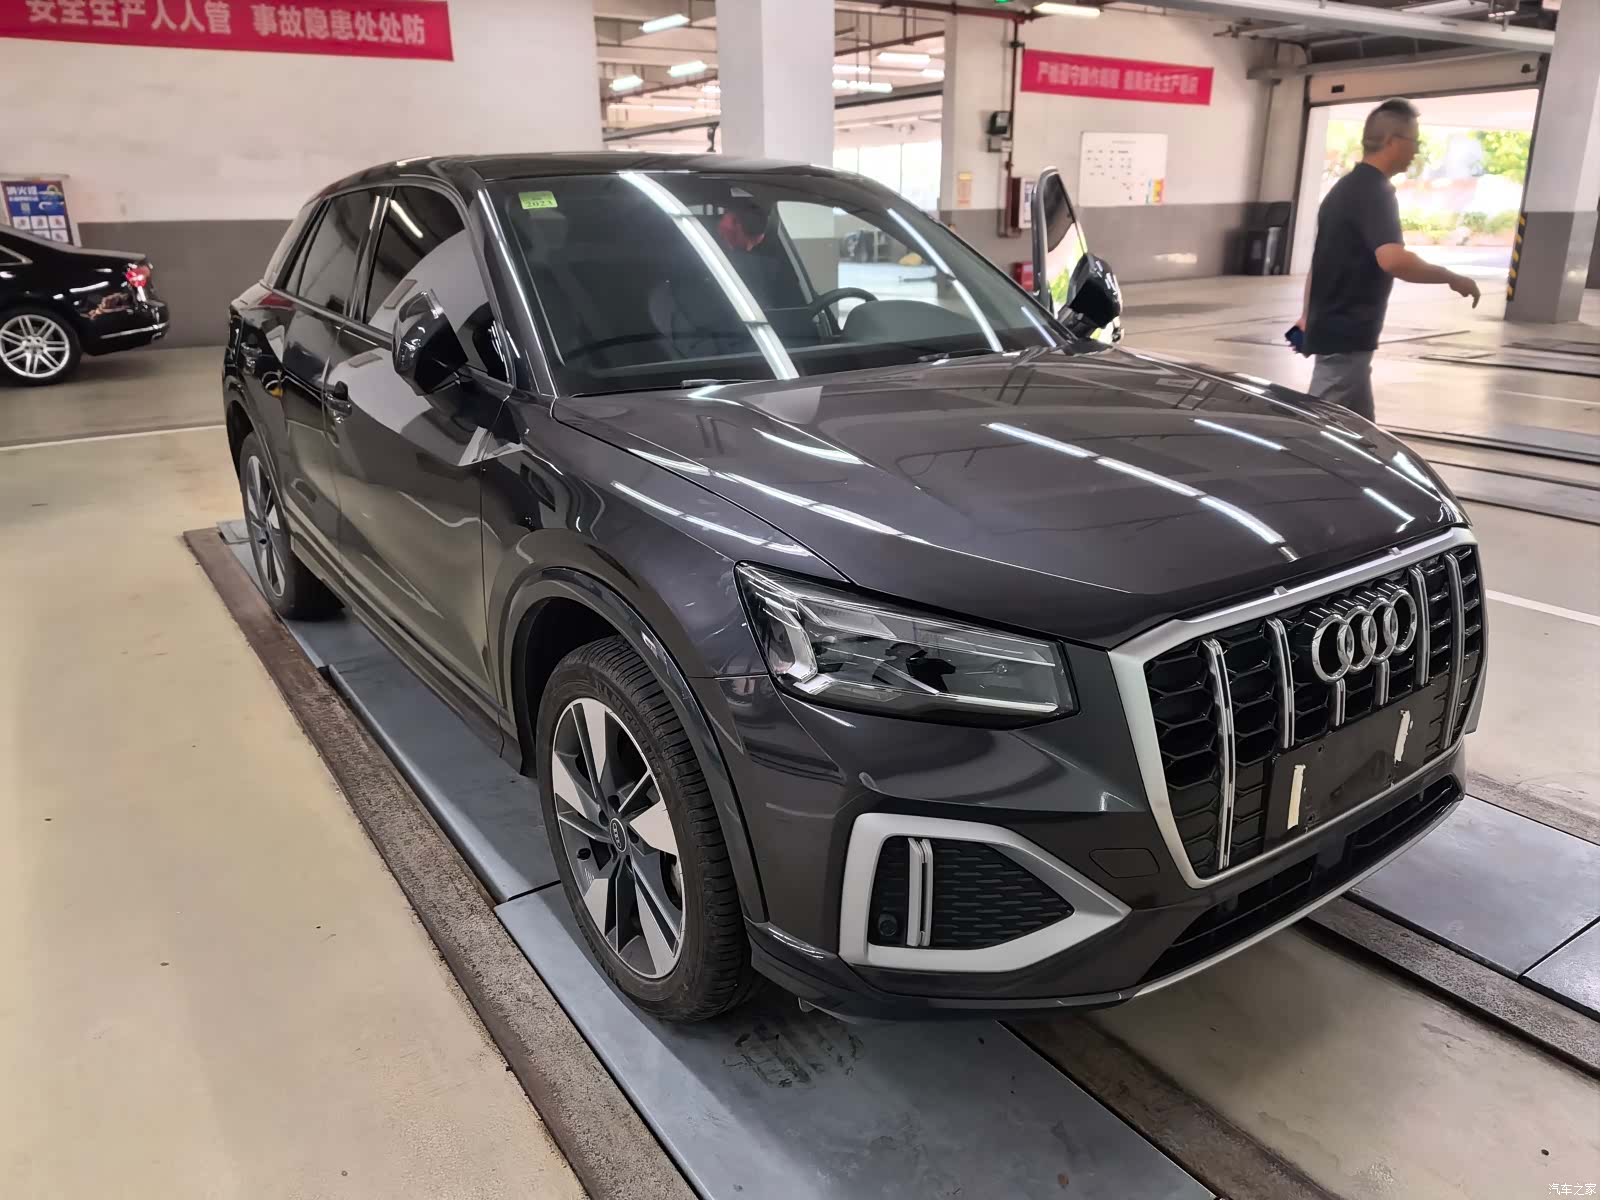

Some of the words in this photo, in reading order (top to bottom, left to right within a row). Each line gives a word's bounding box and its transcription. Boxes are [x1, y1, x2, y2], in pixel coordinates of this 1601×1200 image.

[26, 0, 232, 35] 安全生产人人管
[250, 3, 425, 45] 事故隐患处处防
